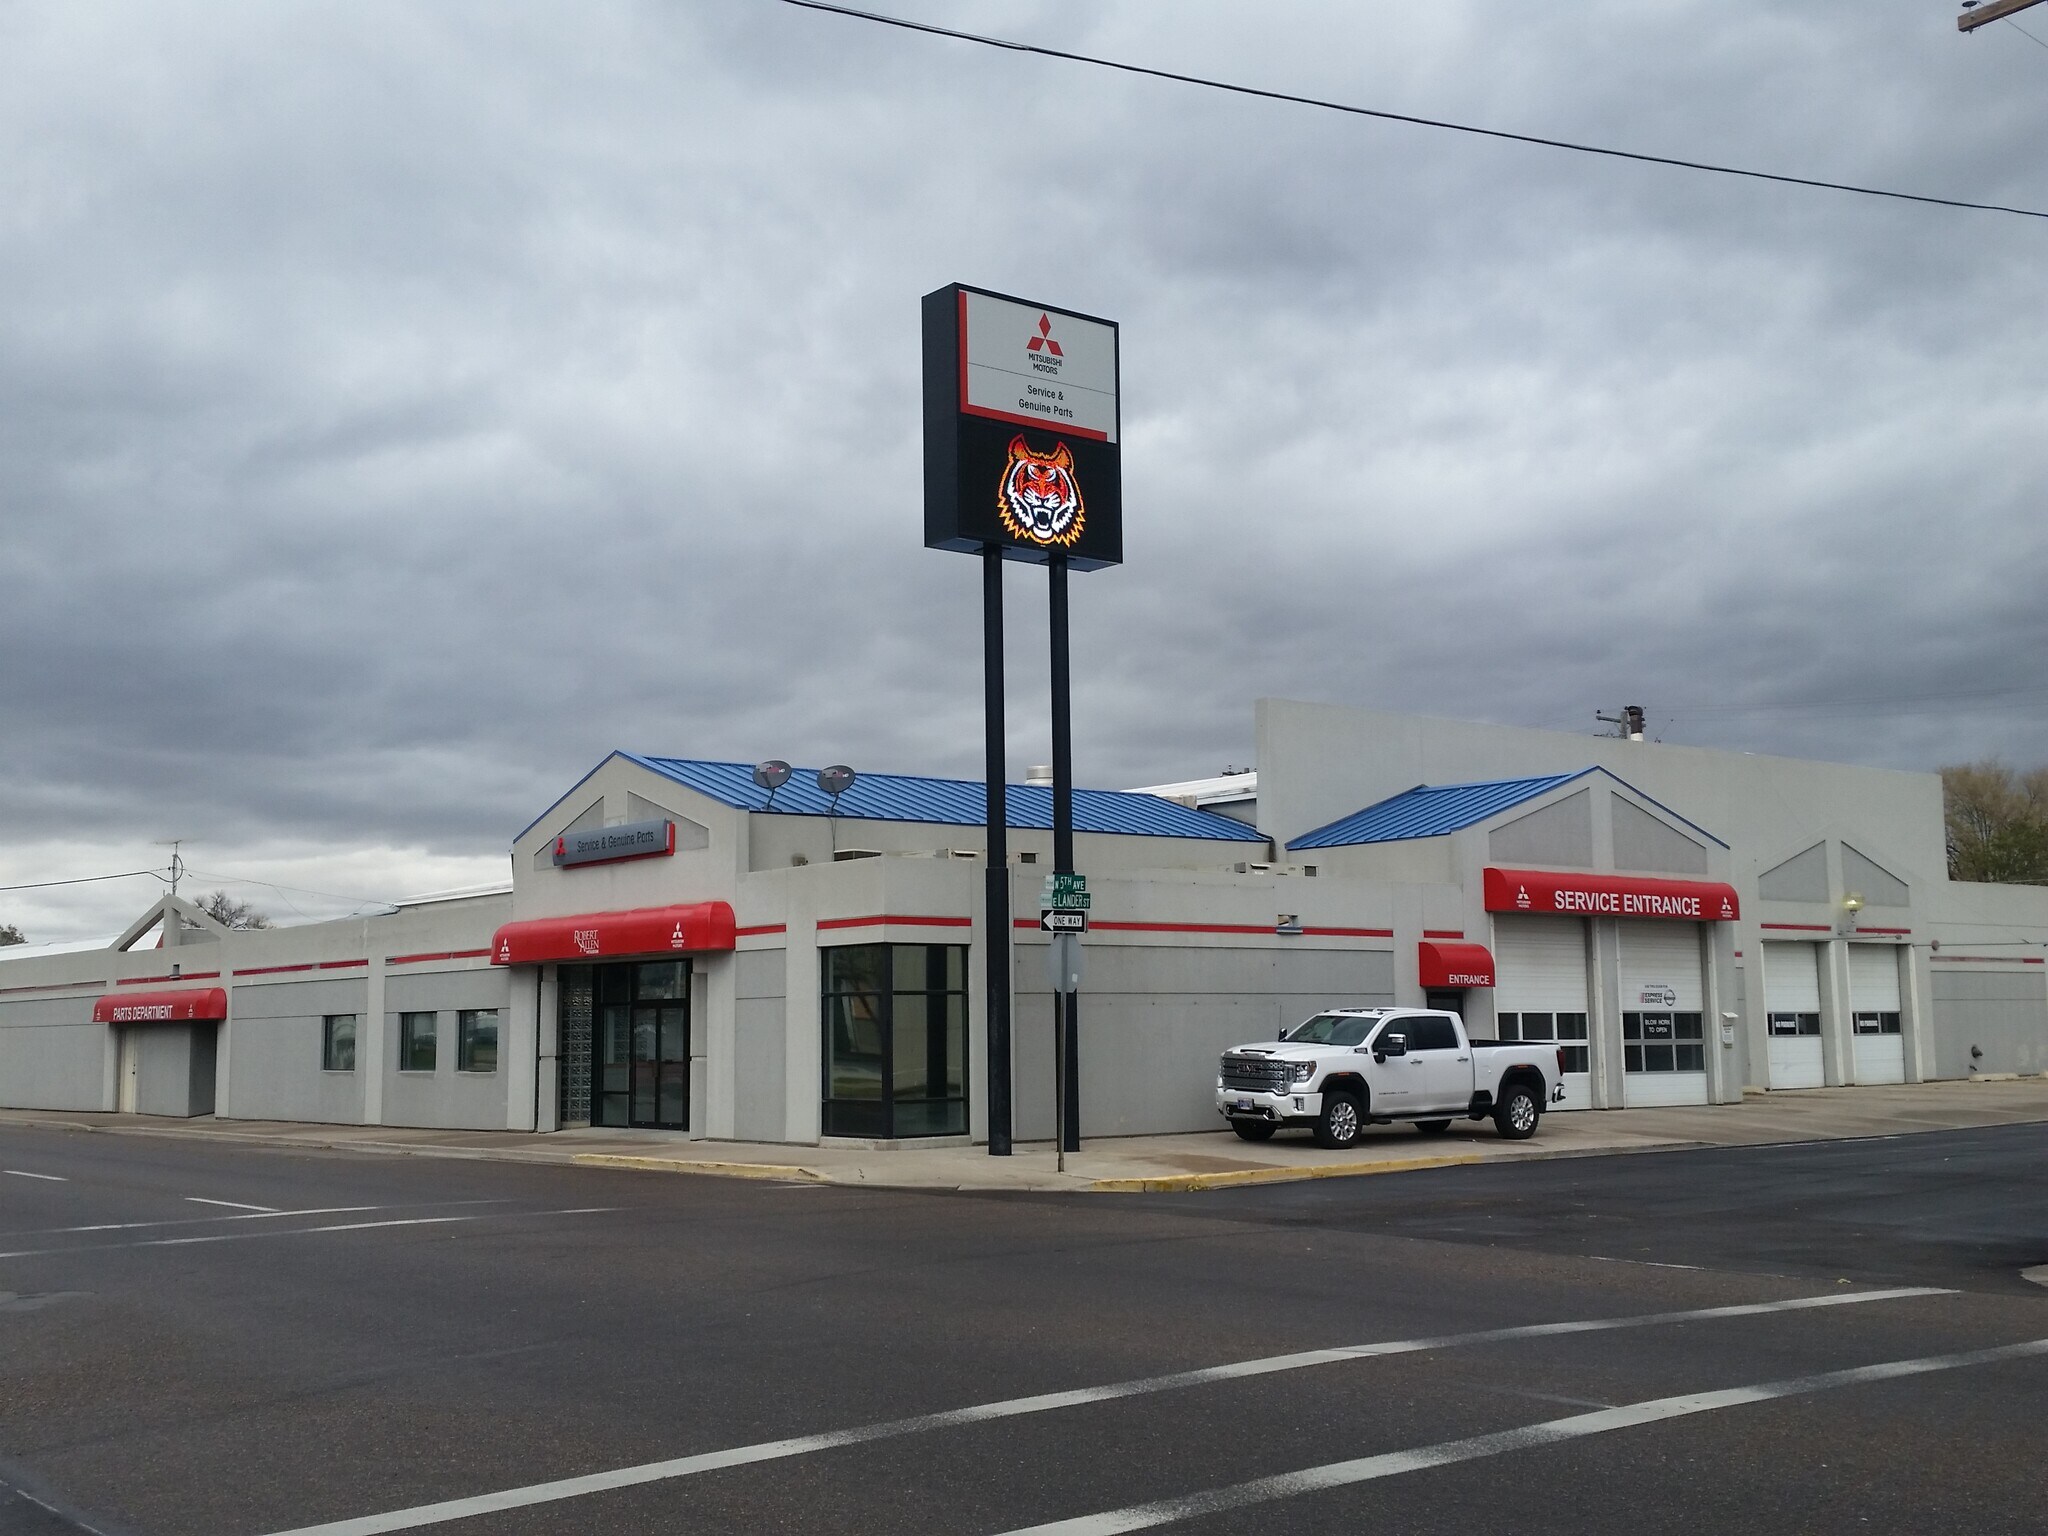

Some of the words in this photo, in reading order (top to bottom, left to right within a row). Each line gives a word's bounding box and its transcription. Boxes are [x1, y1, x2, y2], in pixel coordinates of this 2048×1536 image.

[1029, 353, 1062, 366] MITSUBISHI
[1033, 363, 1058, 375] MOTORS
[1027, 385, 1055, 399] Service
[1058, 391, 1064, 401] &
[1019, 398, 1051, 413] Genuine
[1054, 406, 1073, 418] Parts
[577, 839, 599, 853] Service
[602, 839, 607, 849] &
[608, 834, 634, 848] Genuine
[637, 831, 654, 843] Parts
[1060, 876, 1072, 889] 5TH
[1073, 880, 1084, 890] AVE
[1053, 897, 1057, 907] E
[1058, 893, 1083, 907] LANDER
[1083, 897, 1090, 907] ST
[1555, 890, 1620, 912] SERVICE
[1624, 894, 1701, 915] ENTRANCE
[1054, 916, 1065, 926] ONE
[1068, 916, 1080, 926] WAY
[574, 930, 598, 943] ROBERT
[579, 940, 599, 952] ALLEN
[1449, 974, 1490, 985] ENTRANCE
[113, 1006, 132, 1020] PARTS
[132, 1004, 173, 1019] DEPARTMENT
